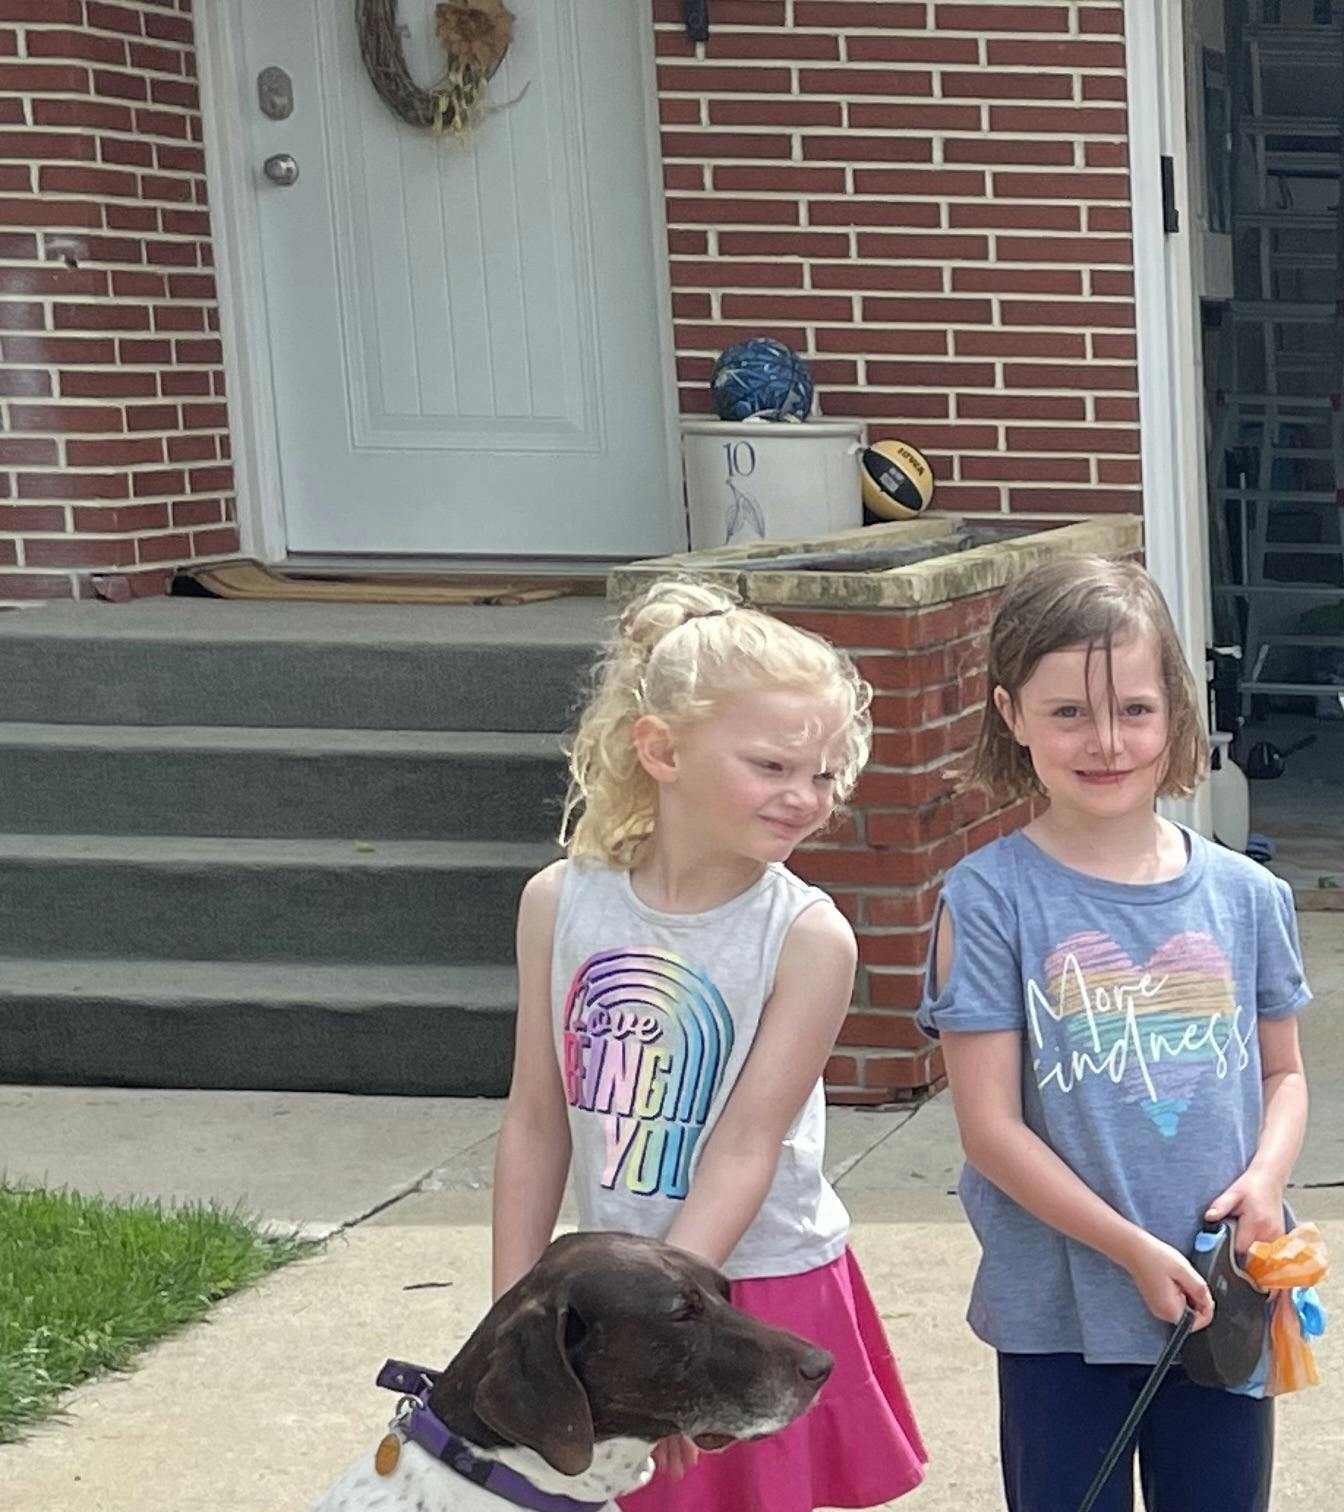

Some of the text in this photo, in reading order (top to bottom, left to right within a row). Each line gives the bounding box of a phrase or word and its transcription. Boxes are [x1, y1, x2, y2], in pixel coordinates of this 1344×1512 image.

[722, 440, 756, 478] 10
[567, 981, 663, 1043] Love
[1027, 953, 1169, 1049] More
[563, 1031, 674, 1121] BEING
[1033, 994, 1257, 1103] indness
[601, 1115, 701, 1200] YOU
